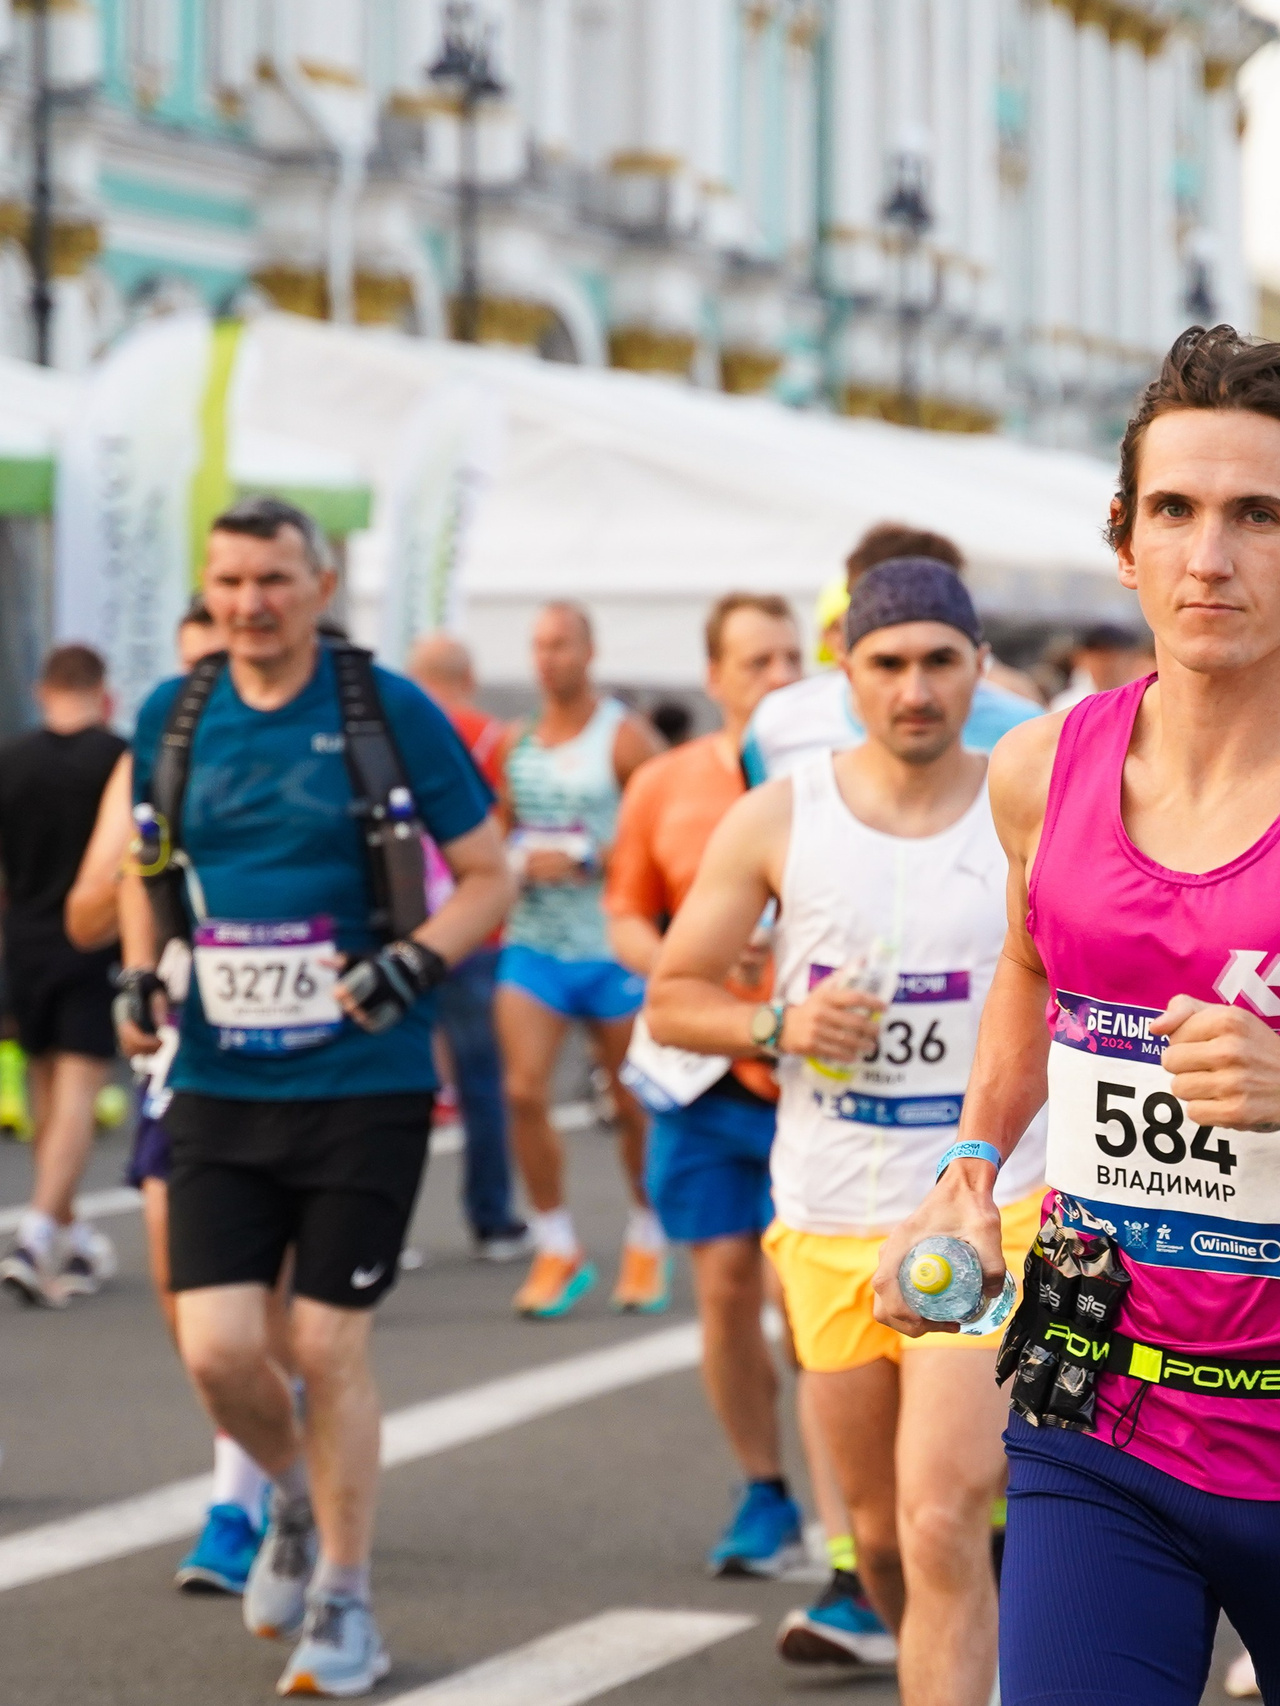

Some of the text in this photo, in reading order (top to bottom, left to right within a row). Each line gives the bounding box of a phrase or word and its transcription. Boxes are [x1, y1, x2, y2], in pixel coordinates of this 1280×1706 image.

[216, 959, 318, 1002] 3276
[1087, 1007, 1156, 1041] БЕЛЫЕ
[1100, 1036, 1134, 1051] 2024
[1094, 1080, 1238, 1176] 584
[1097, 1164, 1236, 1202] ВЛАДИМИР
[1199, 1236, 1258, 1257] Winline
